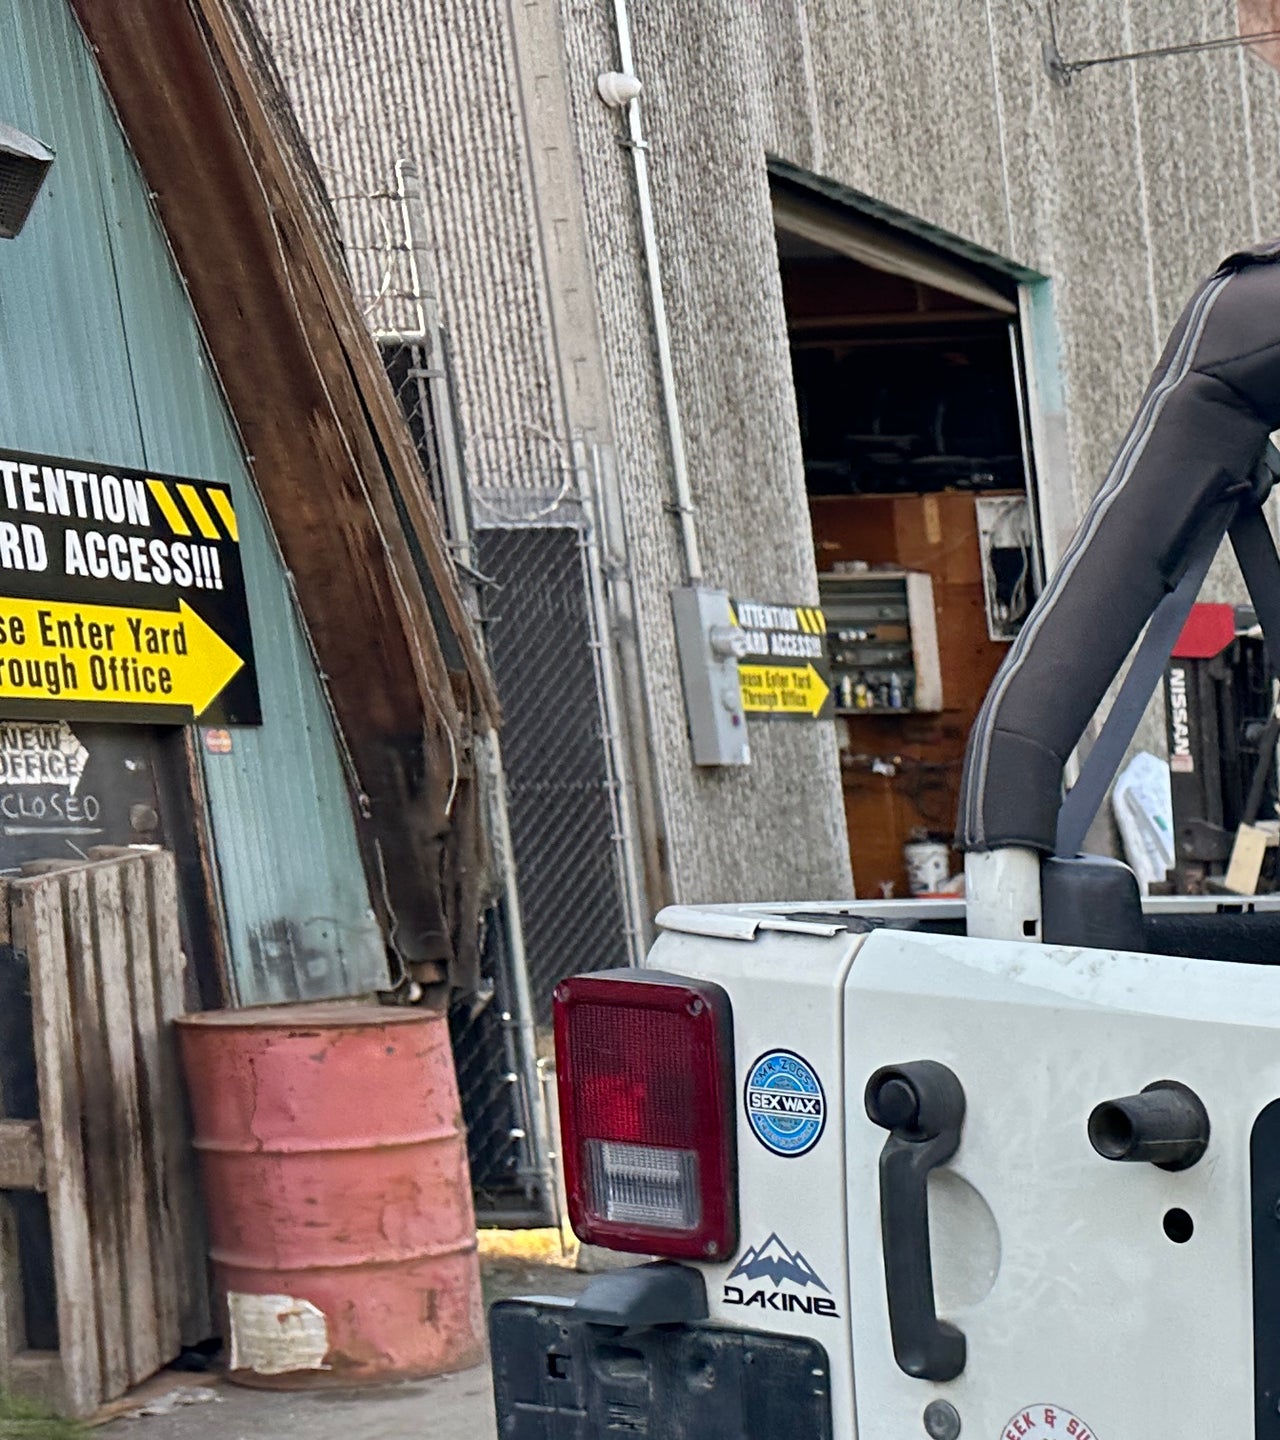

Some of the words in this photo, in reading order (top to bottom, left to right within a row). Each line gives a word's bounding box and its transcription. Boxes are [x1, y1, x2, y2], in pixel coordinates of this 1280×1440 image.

[0, 460, 150, 526] TENTION
[65, 529, 223, 590] ACCESS!!!
[38, 610, 115, 650] Enter
[127, 617, 188, 655] Yard
[744, 630, 769, 655] ARD
[90, 655, 172, 694] Office
[1170, 668, 1190, 755] NISSAN
[0, 727, 62, 750] NEW
[1, 793, 99, 821] CLOSED
[759, 1062, 776, 1079] MR
[780, 1059, 812, 1084] ZOGS
[751, 1093, 782, 1110] SEX
[782, 1096, 817, 1114] WAX
[722, 1285, 841, 1318] DAKINE
[1044, 1408, 1057, 1429] &
